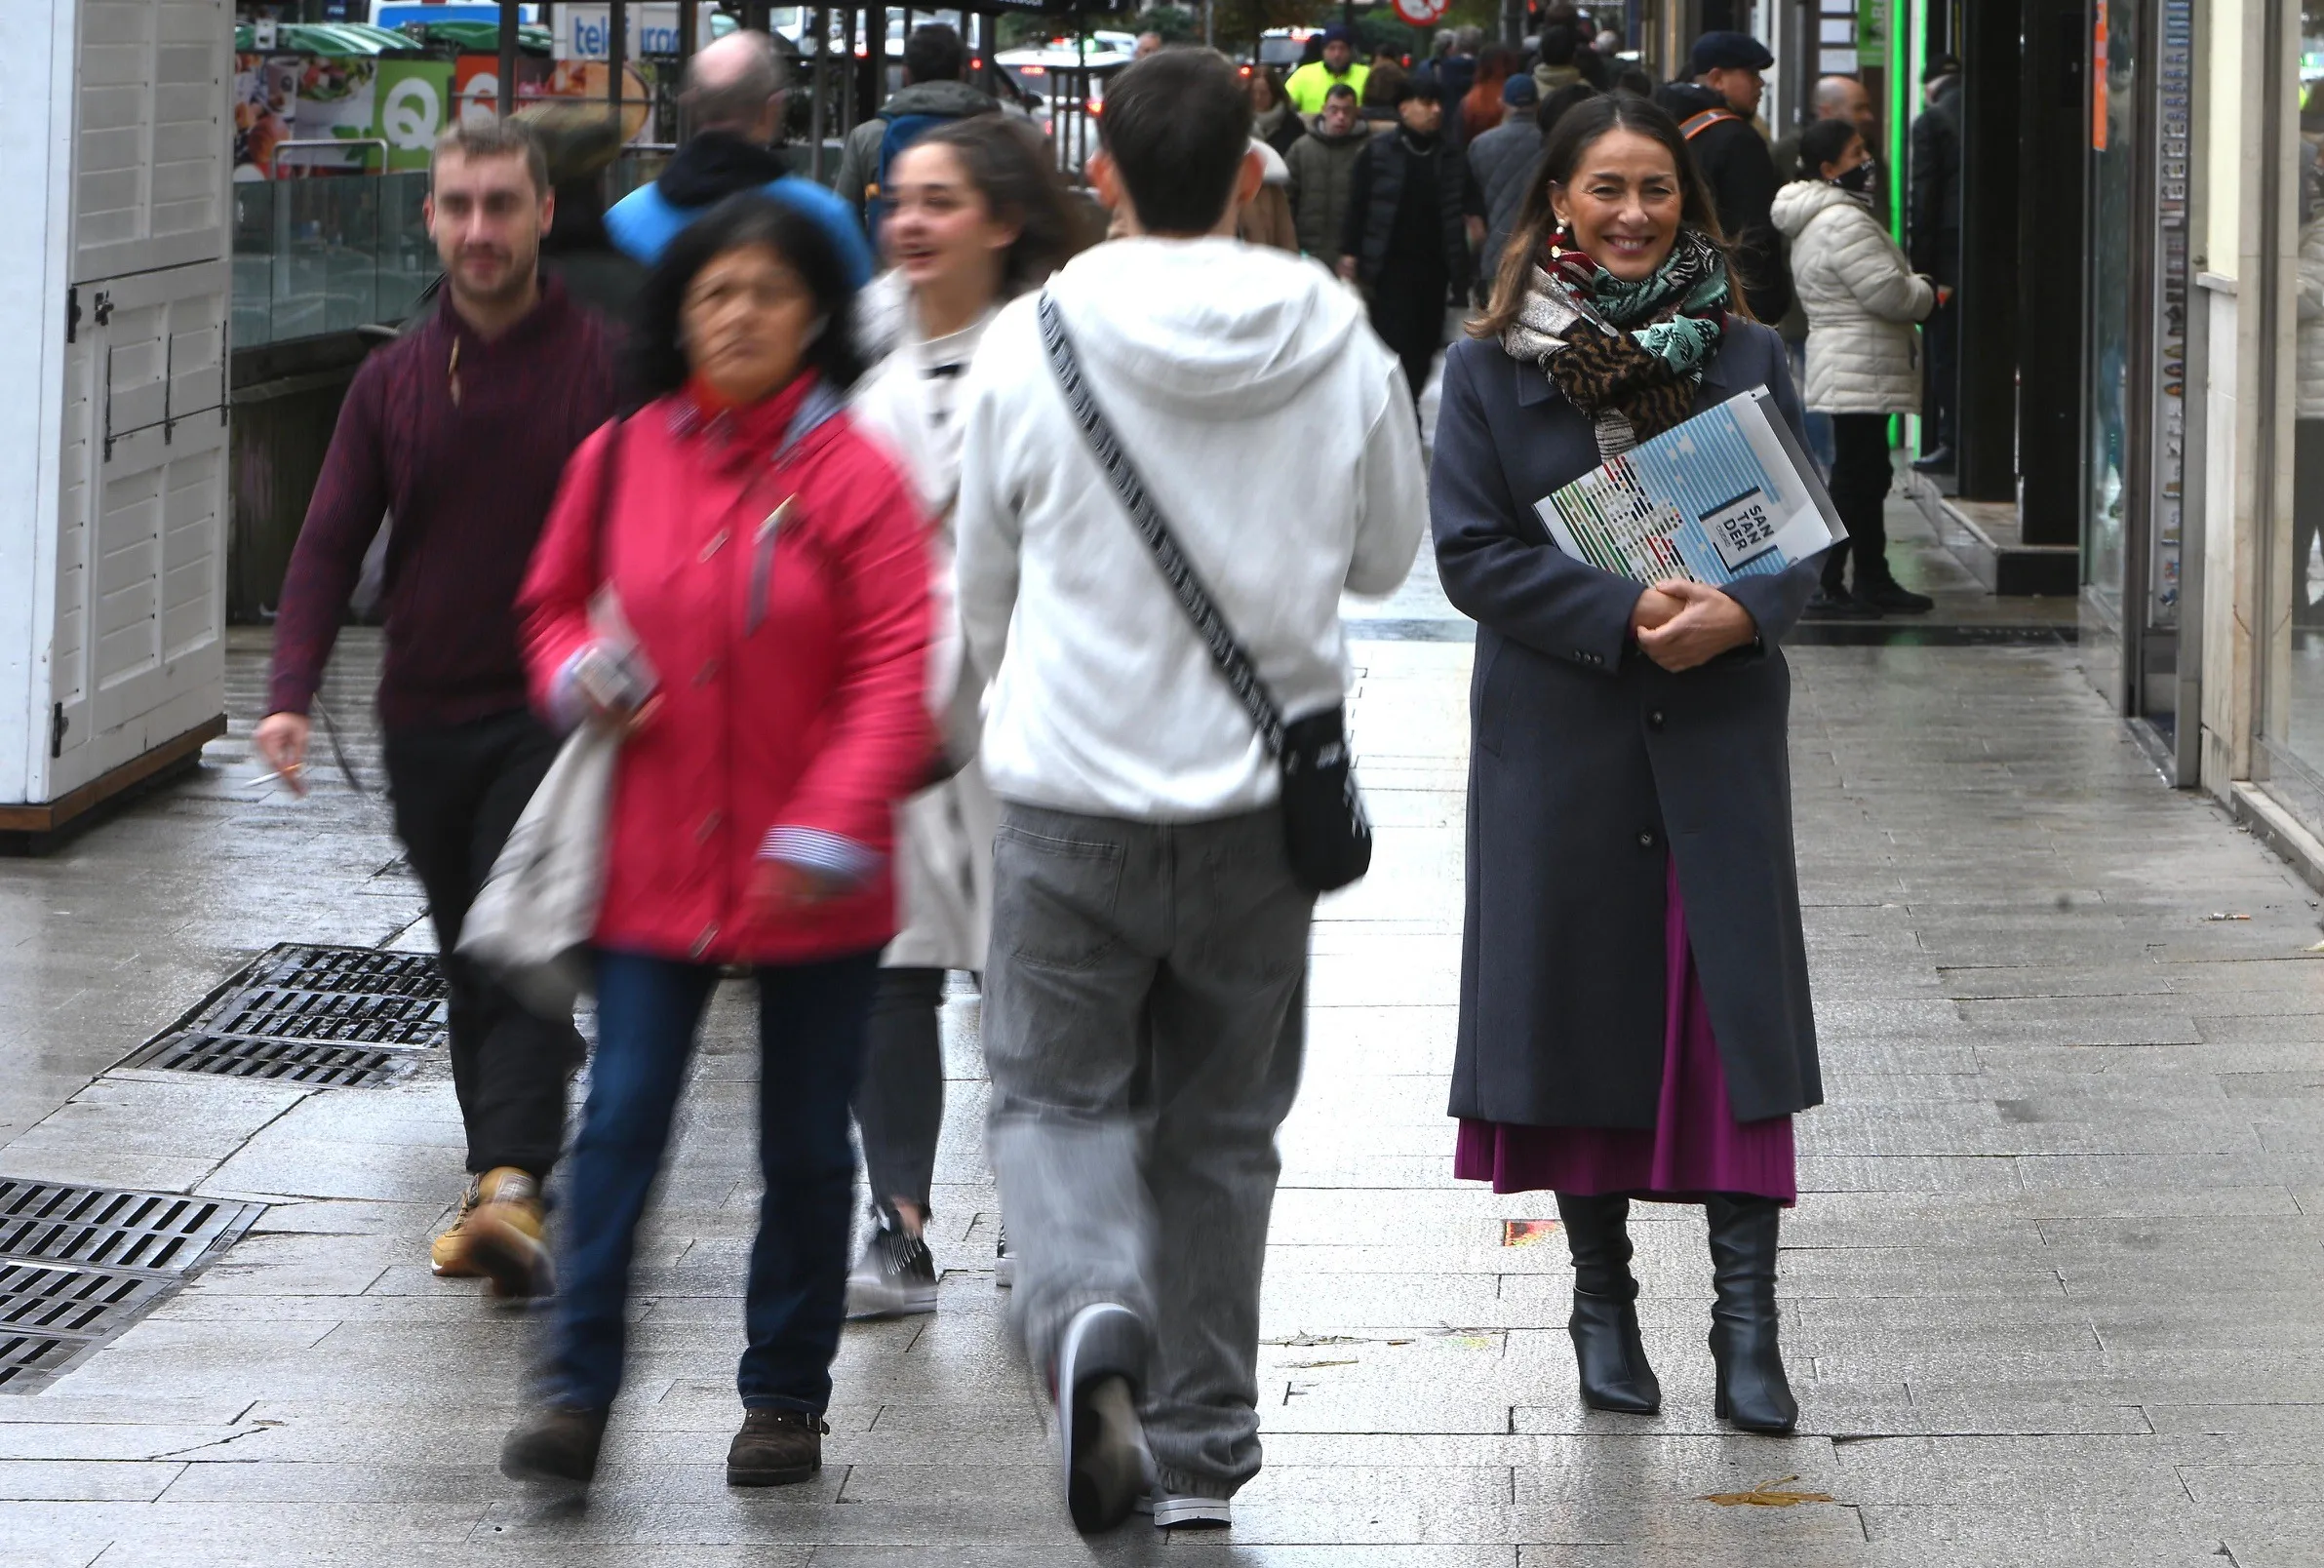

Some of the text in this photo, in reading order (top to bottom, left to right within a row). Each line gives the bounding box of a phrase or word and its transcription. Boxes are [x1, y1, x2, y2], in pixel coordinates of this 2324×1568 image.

[382, 77, 439, 150] Q
[1722, 518, 1748, 552] DER
[1737, 511, 1761, 545] TAN
[1749, 504, 1775, 538] SAN
